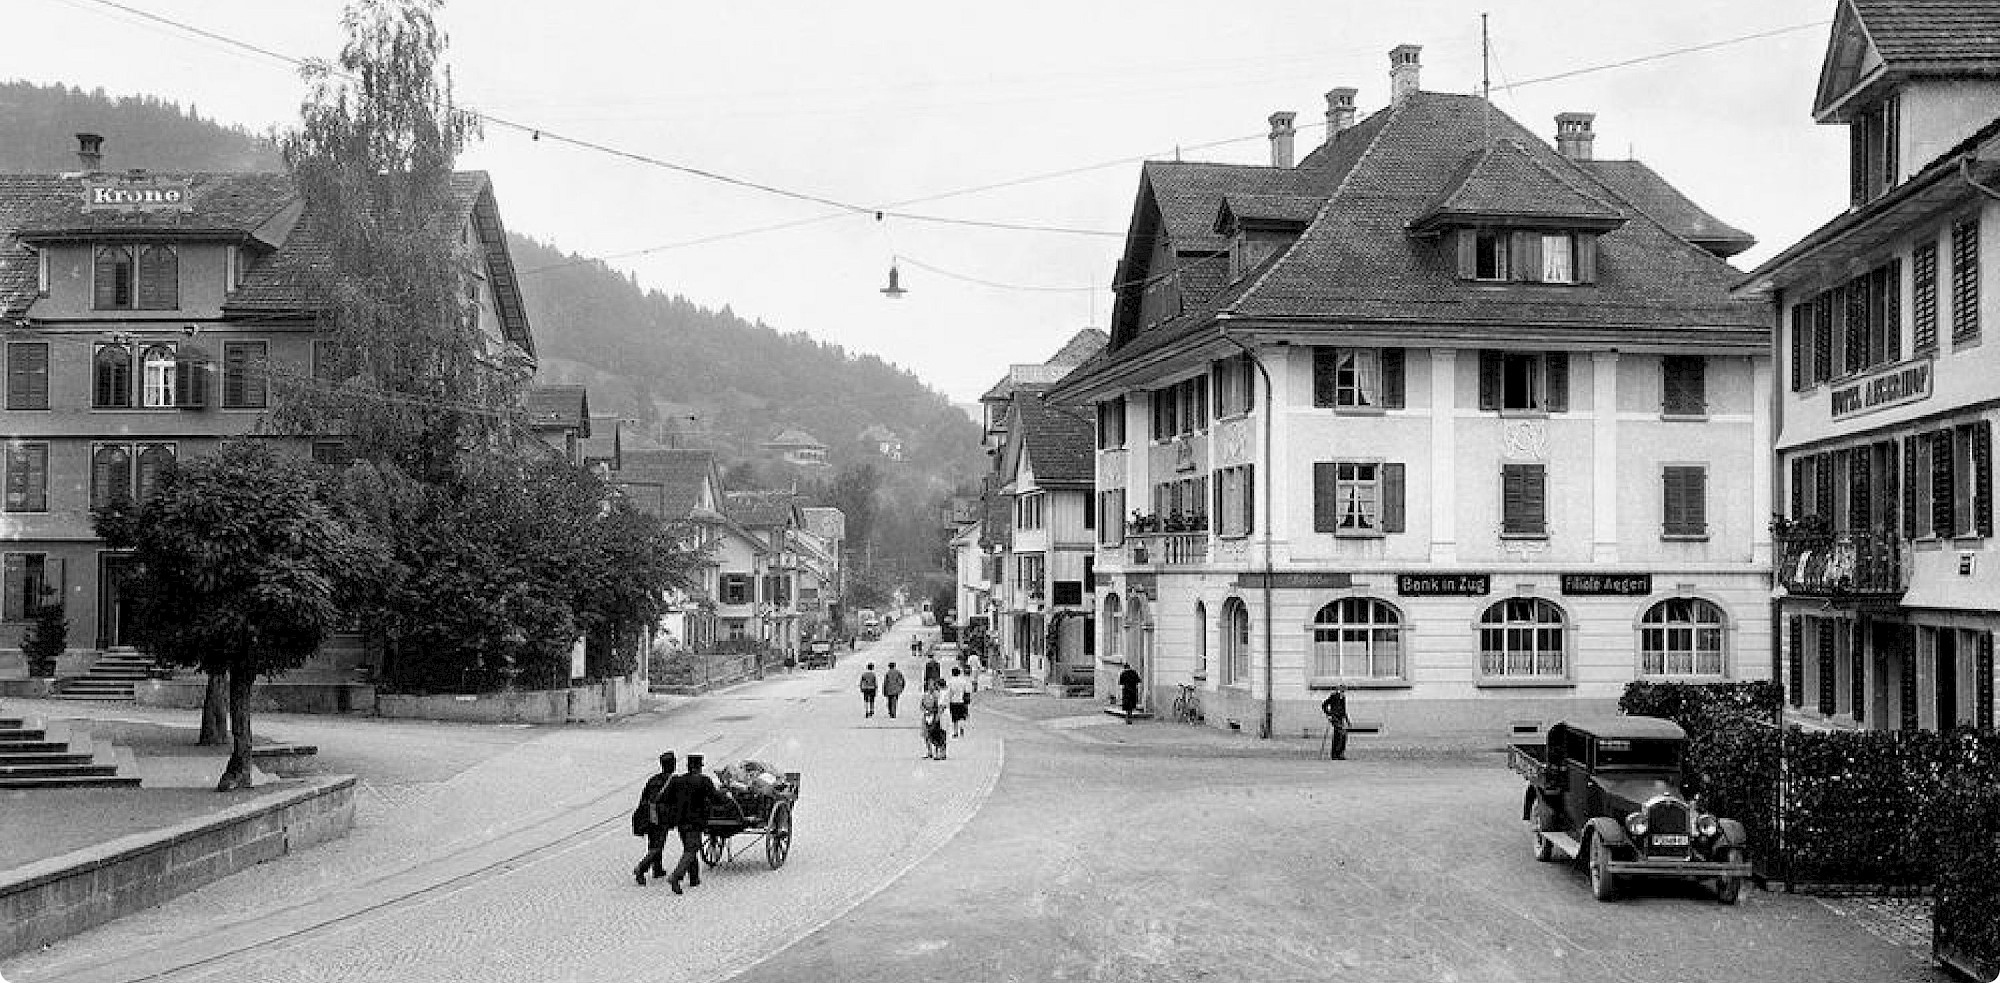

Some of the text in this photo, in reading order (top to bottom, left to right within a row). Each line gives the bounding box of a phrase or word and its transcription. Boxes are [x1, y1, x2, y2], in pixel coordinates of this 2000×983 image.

[94, 187, 180, 204] Krone
[1401, 575, 1485, 594] Bank in Zug
